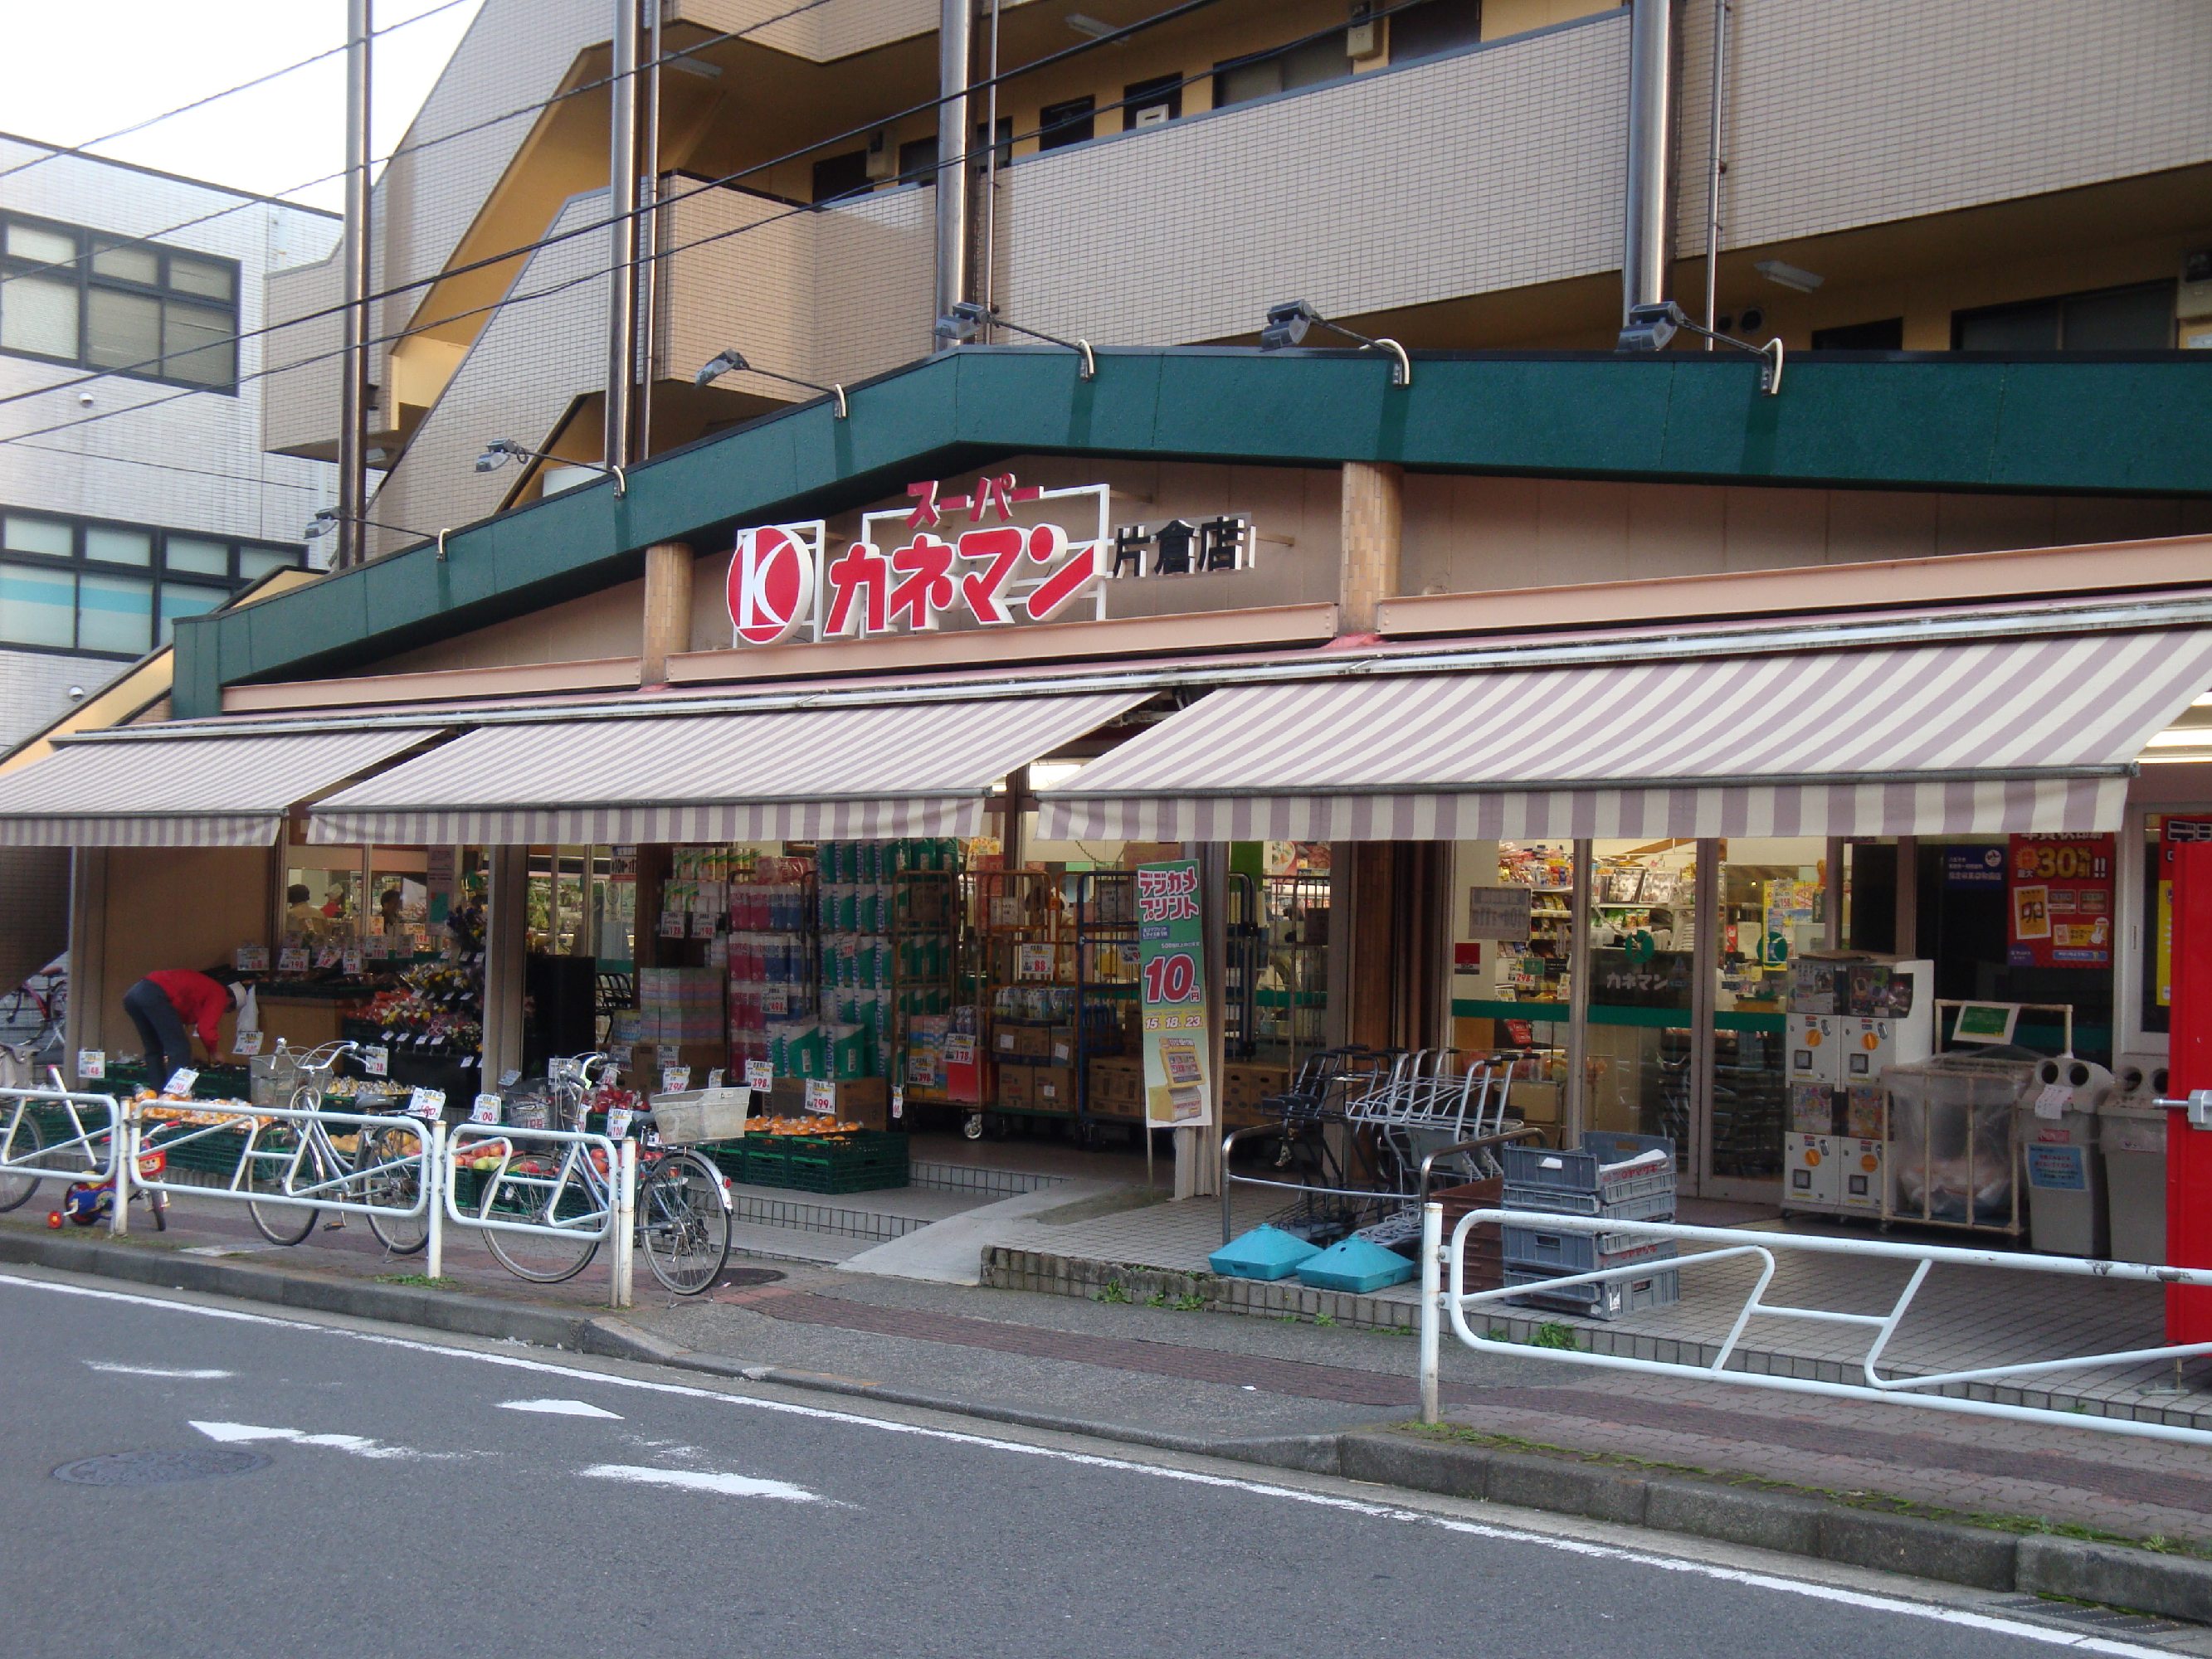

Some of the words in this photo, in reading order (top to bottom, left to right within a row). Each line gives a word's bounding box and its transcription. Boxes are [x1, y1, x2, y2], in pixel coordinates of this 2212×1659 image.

[907, 473, 1044, 528] スーパー
[1113, 516, 1246, 578] 片倉店
[824, 523, 1107, 637] カネマン
[1138, 865, 1198, 898] デジカメ
[1139, 895, 1200, 922] プリント
[1034, 959, 1046, 972] 88
[1606, 971, 1669, 990] カネマン
